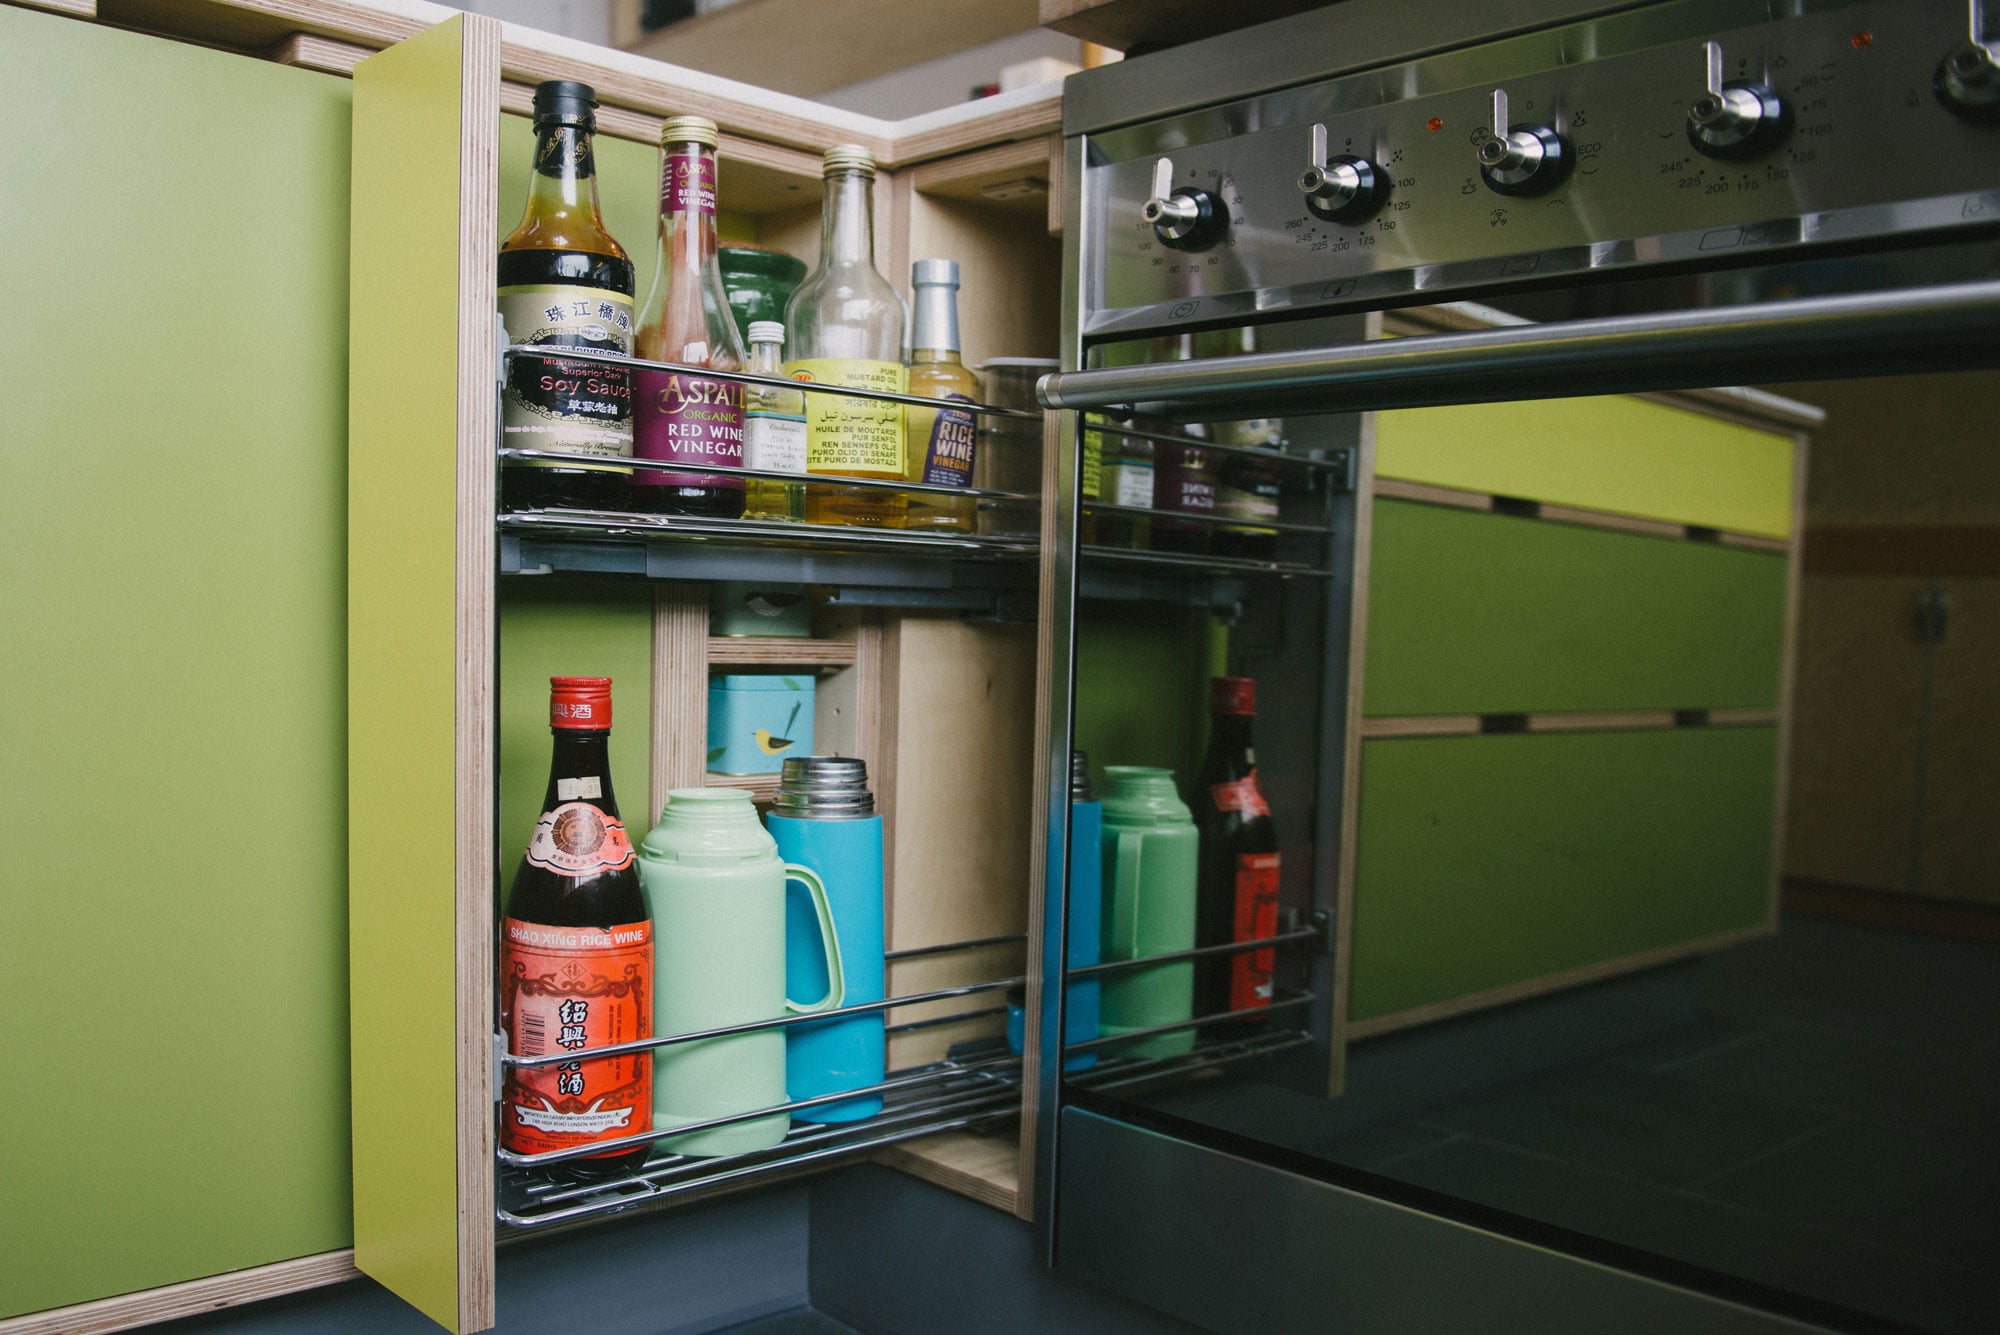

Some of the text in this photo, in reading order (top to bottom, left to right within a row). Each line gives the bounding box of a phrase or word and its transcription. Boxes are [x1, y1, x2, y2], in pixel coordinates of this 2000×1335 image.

[1527, 101, 1533, 110] 0
[1809, 123, 1832, 136] 100
[1578, 143, 1601, 155] ECO
[1660, 162, 1684, 174] 245
[1766, 168, 1789, 181] 150
[1398, 177, 1416, 188] 100
[1678, 176, 1702, 188] 225
[1737, 179, 1759, 191] 175
[1705, 182, 1729, 195] 200
[1232, 196, 1243, 205] 30
[1393, 201, 1411, 211] 125
[1233, 217, 1244, 225] 40
[1285, 219, 1303, 230] 260
[1378, 221, 1396, 231] 150
[1296, 234, 1312, 244] 245
[1358, 236, 1375, 246] 175
[1311, 241, 1328, 252] 225
[1332, 241, 1350, 252] 200
[1189, 265, 1200, 273] 70
[562, 366, 622, 379] Superior Dark
[847, 373, 886, 382] MUSTARD
[880, 368, 897, 376] PURE
[540, 376, 631, 399] Soy Sauce
[655, 375, 746, 414] ASPALL
[683, 409, 738, 424] ORGANIC
[668, 423, 744, 442] RED WINE
[815, 425, 841, 433] HUILE
[857, 427, 897, 436] MOUTARDE
[938, 420, 974, 446] RICE
[668, 439, 744, 458] VINEGAR
[842, 442, 879, 450] SENNEPS
[936, 439, 973, 462] WINE
[871, 450, 897, 459] SENAPE
[933, 455, 970, 472] VINEGAR
[511, 927, 643, 946] SHAO XING RICE WINE
